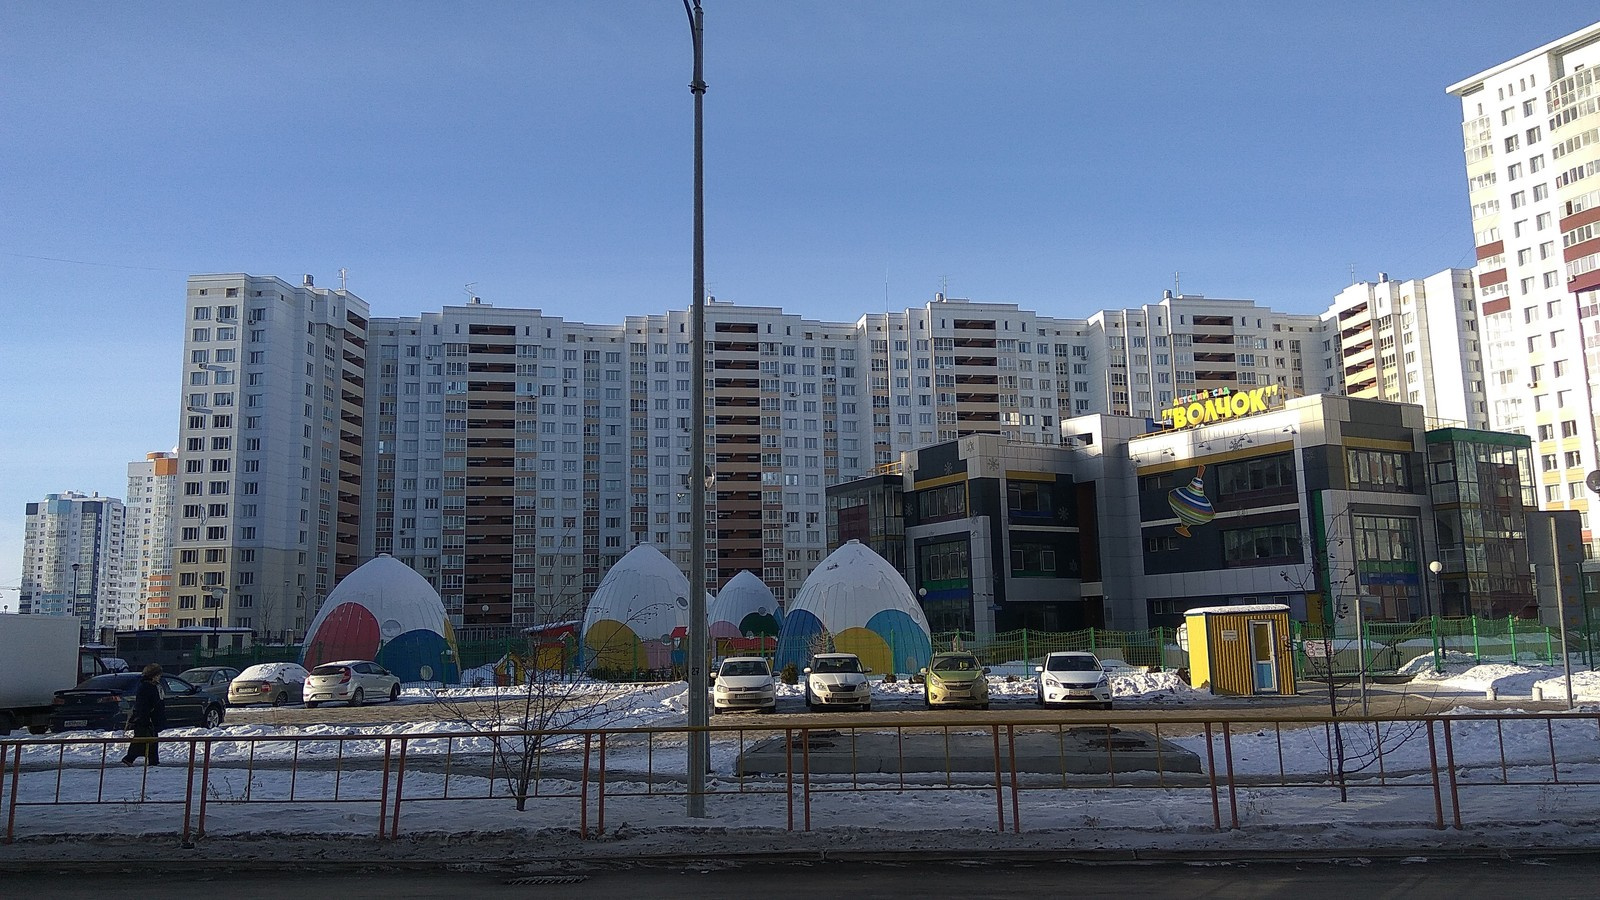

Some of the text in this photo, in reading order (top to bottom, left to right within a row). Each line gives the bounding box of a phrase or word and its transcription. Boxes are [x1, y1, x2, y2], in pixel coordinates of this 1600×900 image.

[1173, 386, 1230, 406] ДЕТСКИЙ САД
[1161, 384, 1278, 429] "ВОЛЧОК"
[691, 667, 700, 676] 27
